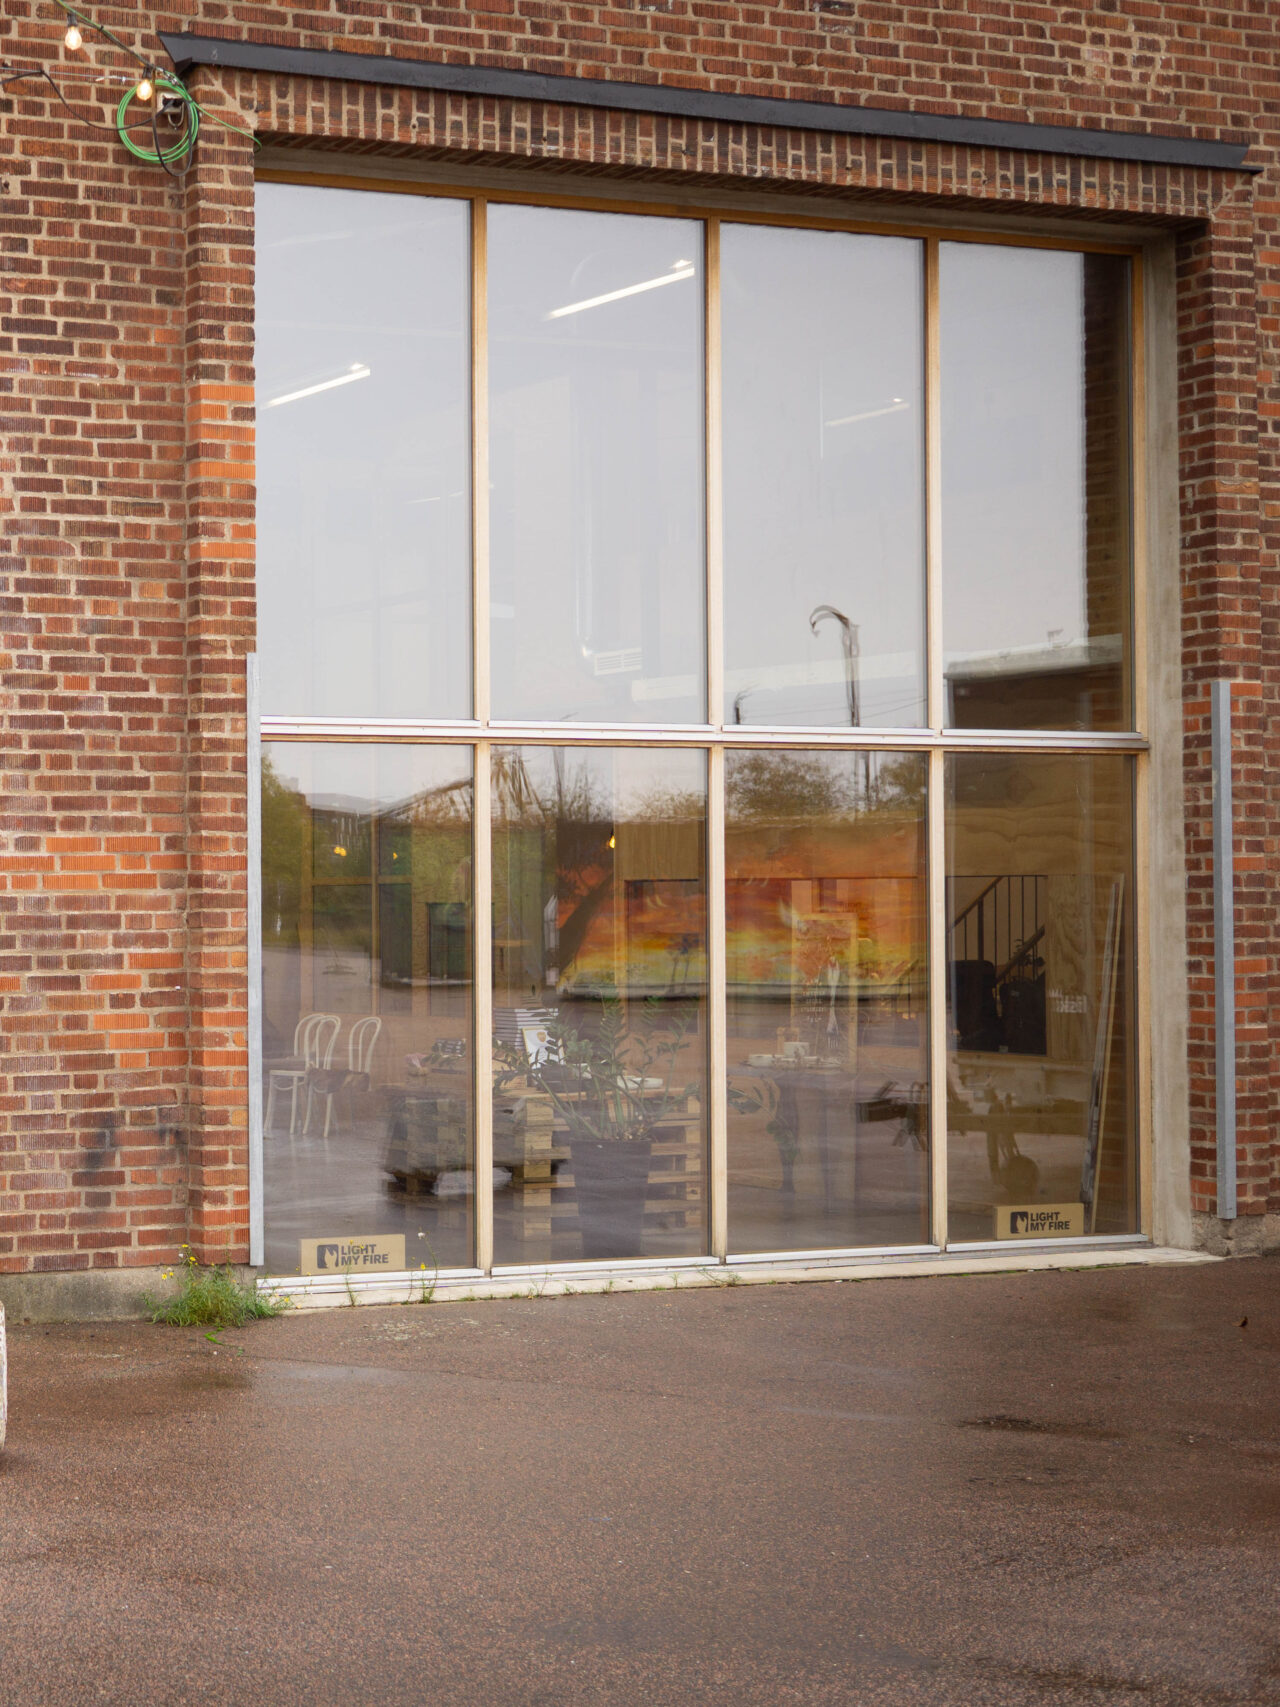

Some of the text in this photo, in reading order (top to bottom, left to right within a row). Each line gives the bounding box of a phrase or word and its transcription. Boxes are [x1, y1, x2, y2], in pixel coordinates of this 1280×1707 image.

[1030, 1212, 1060, 1221] LIGHT
[1030, 1221, 1070, 1231] MY FIRE
[341, 1244, 376, 1255] LIGHT
[341, 1254, 389, 1265] MY FIRE
